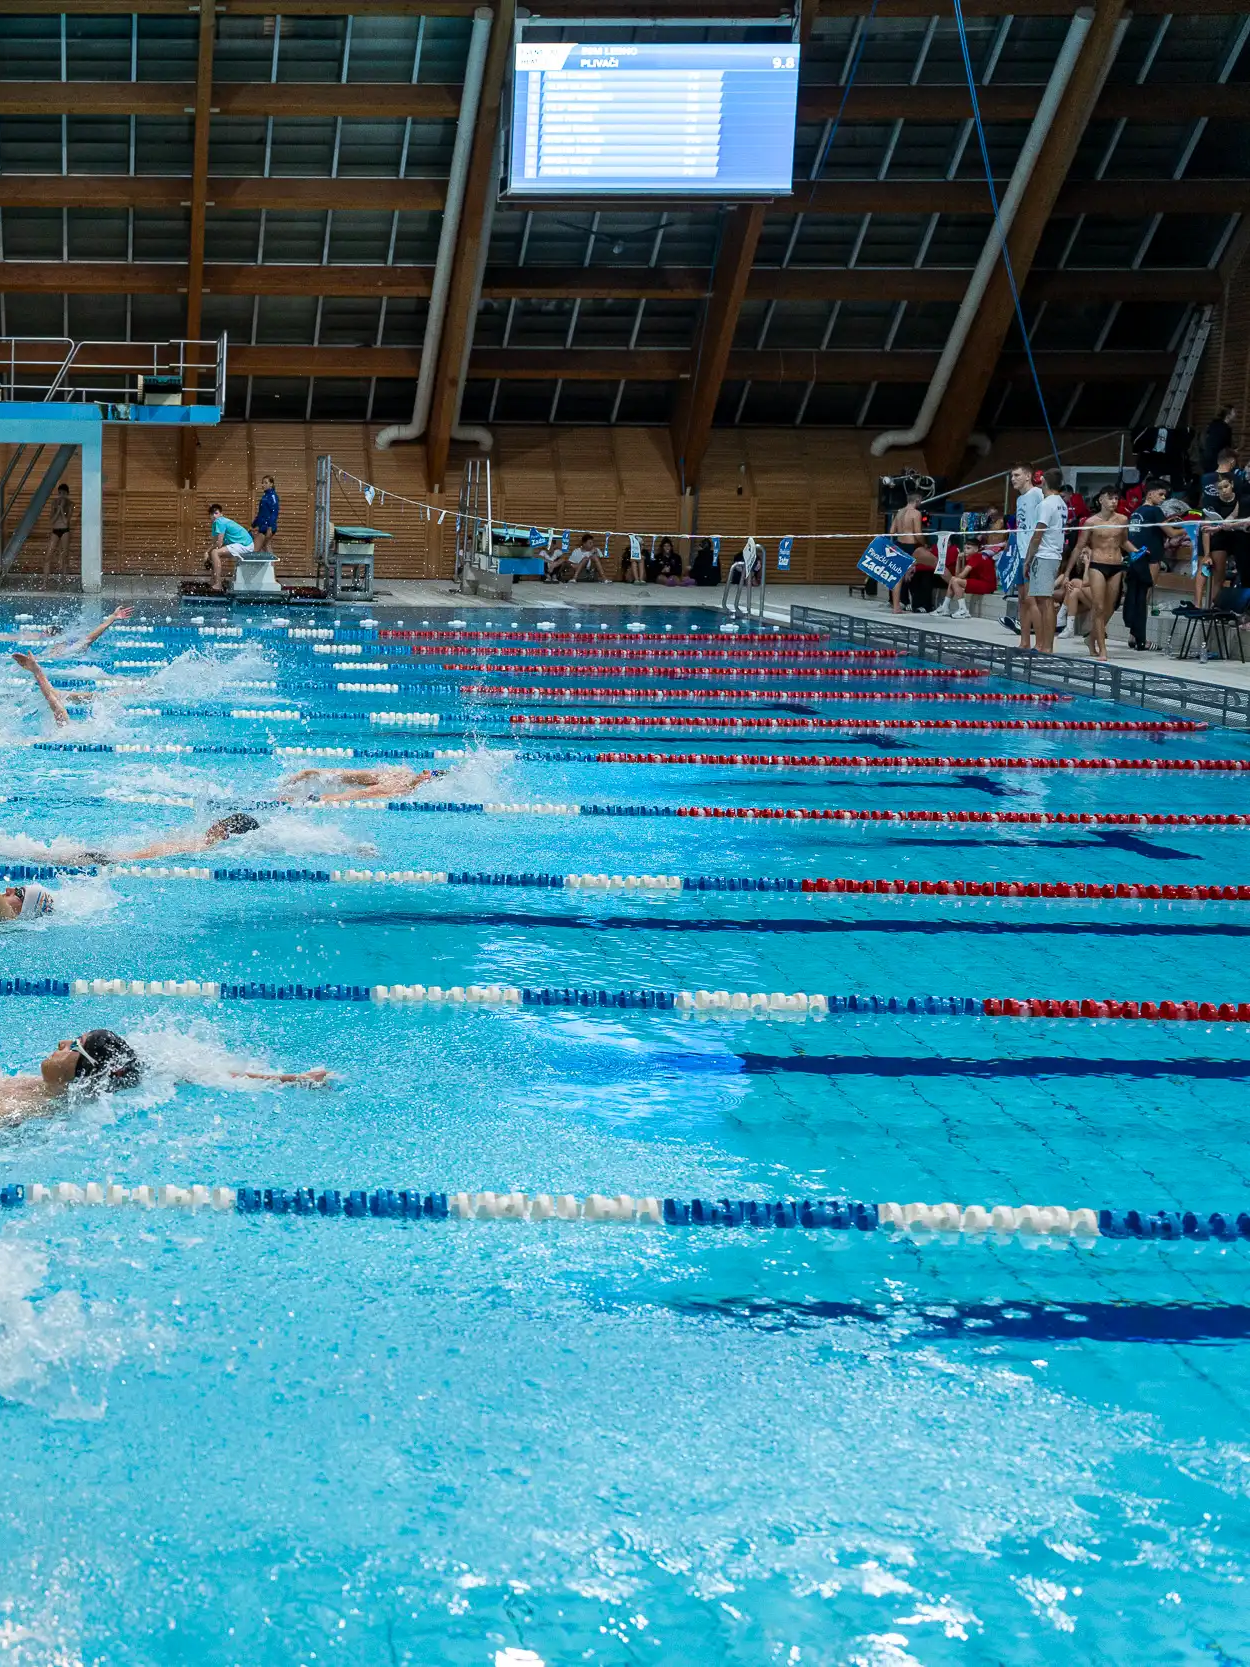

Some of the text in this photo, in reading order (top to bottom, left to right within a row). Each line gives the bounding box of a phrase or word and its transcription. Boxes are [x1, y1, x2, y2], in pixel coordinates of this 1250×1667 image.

[772, 57, 796, 69] 9.8
[861, 554, 897, 583] Zadar
[888, 561, 903, 574] klub
